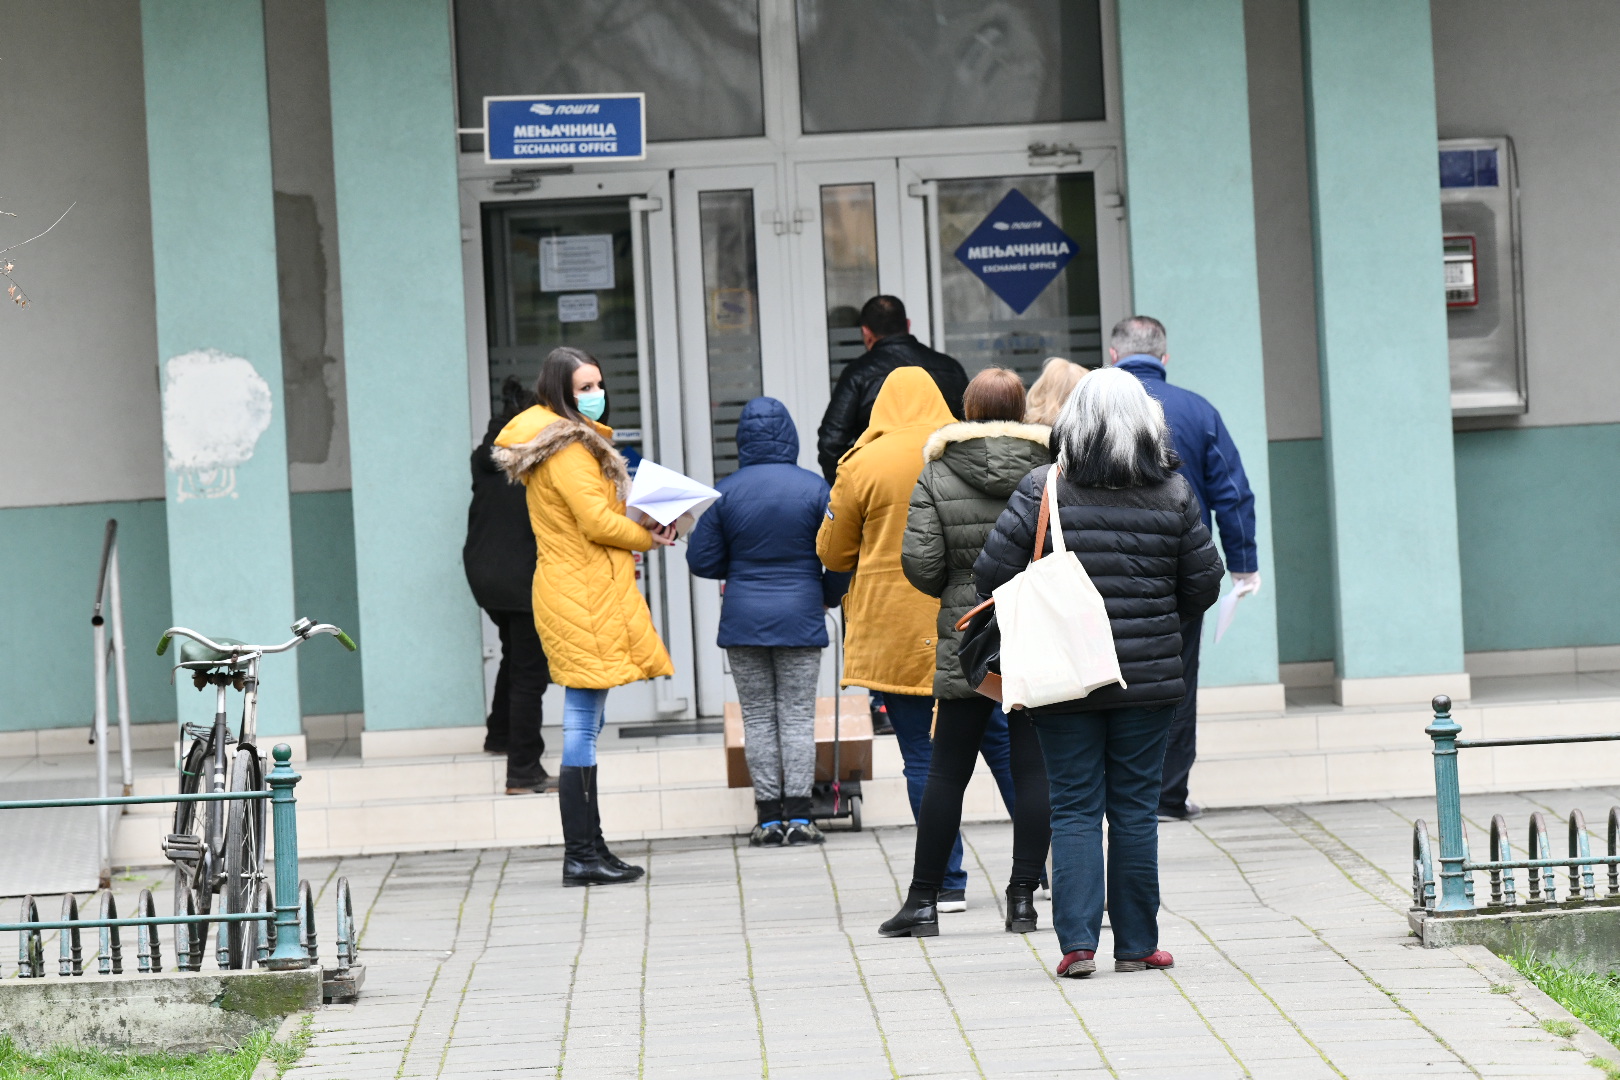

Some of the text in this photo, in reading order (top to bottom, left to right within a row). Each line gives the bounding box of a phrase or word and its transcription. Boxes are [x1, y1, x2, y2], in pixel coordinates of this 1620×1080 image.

[555, 104, 600, 115] ПОШТА
[513, 123, 617, 138] МЕЊАЧНИЦА
[513, 142, 618, 155] EXCHANGE OFFICE
[968, 241, 1070, 260] МЕЊАЧНИЦА
[982, 261, 1057, 273] EXCHANGE OFFICE
